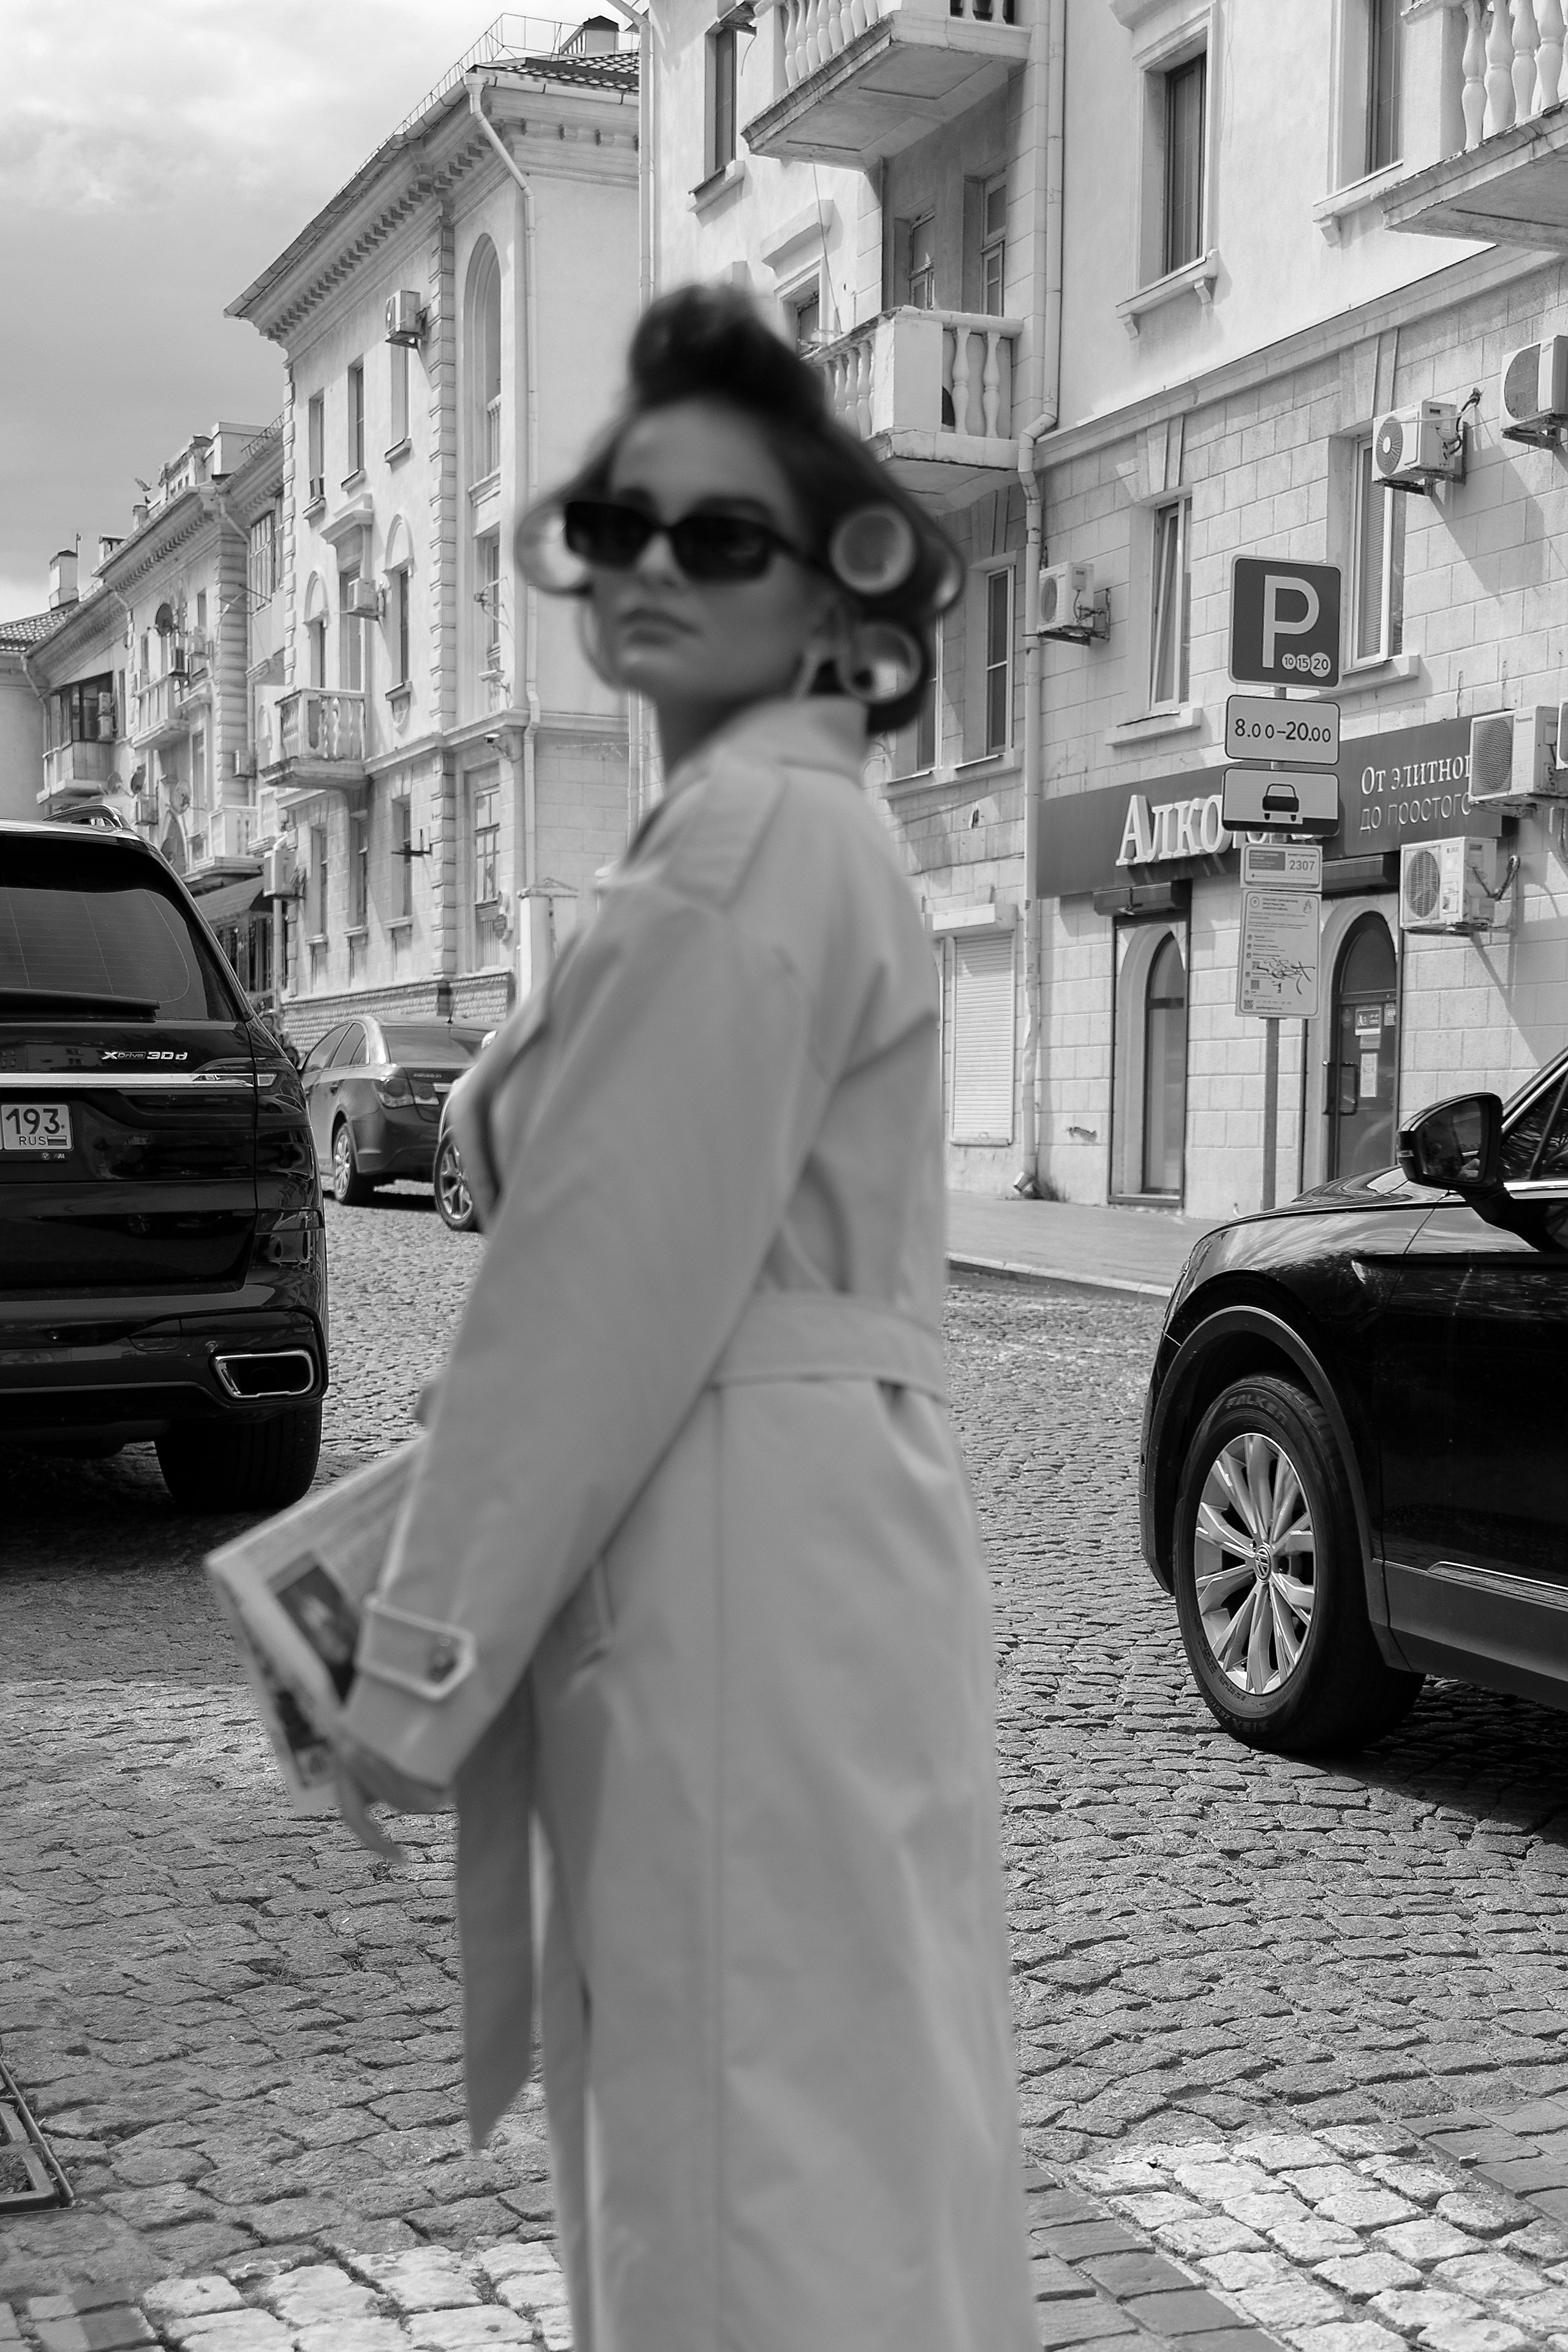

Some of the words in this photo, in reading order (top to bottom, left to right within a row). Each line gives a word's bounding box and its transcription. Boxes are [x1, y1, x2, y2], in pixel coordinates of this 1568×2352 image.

[1262, 575, 1319, 668] P
[1284, 657, 1294, 666] 10
[1298, 658, 1309, 668] 15
[1313, 658, 1329, 670] 20
[1361, 766, 1385, 794] От
[1359, 806, 1382, 831] до
[1289, 859, 1316, 871] 2307
[6, 1108, 61, 1135] 193
[19, 1136, 47, 1146] RUS
